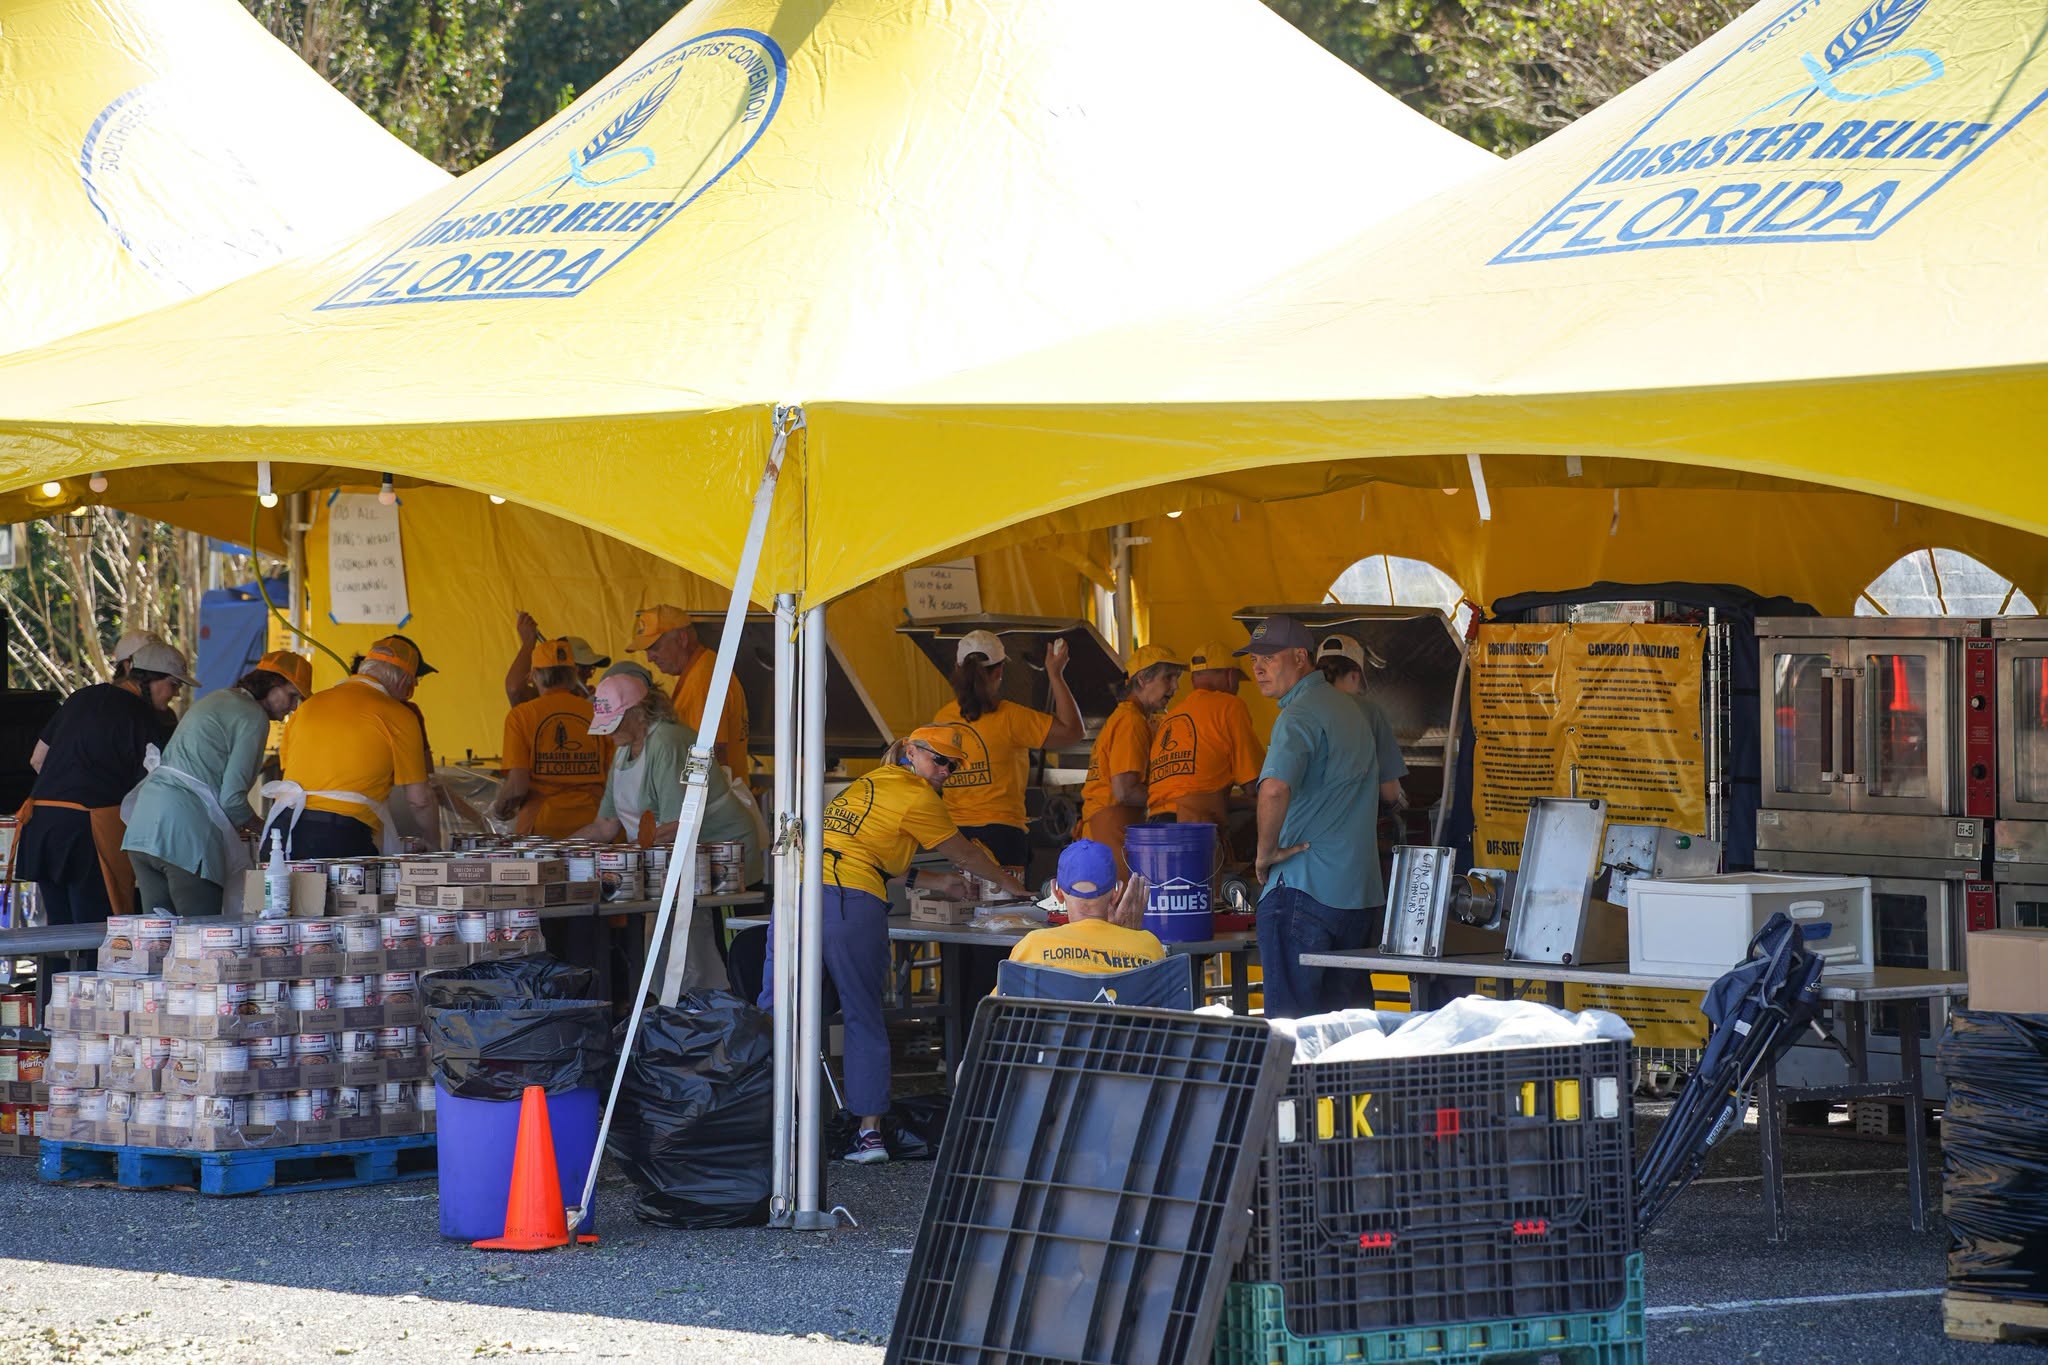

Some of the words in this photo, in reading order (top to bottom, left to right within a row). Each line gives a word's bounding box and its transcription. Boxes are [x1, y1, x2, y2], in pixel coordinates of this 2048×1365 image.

[660, 42, 735, 70] BAPTIST
[727, 45, 770, 124] CONVENTION
[1596, 121, 1826, 186] DISASTER
[1809, 119, 1993, 161] RELIEF
[407, 202, 570, 249] DISASTER
[551, 201, 676, 233] RELIEF
[1516, 180, 1901, 253] FLORIDA
[336, 248, 605, 301] FLORIDA
[1587, 643, 1629, 657] CAMBRO
[1632, 644, 1680, 659] HANDLING
[538, 762, 597, 772] FLORIDA
[835, 807, 860, 823] RELIEF
[1486, 839, 1521, 856] OFF-SITE
[1421, 853, 1434, 877] CAN
[1147, 892, 1208, 911] LOWE'S
[1416, 882, 1430, 926] OPENER
[1043, 948, 1091, 960] FLORIDA
